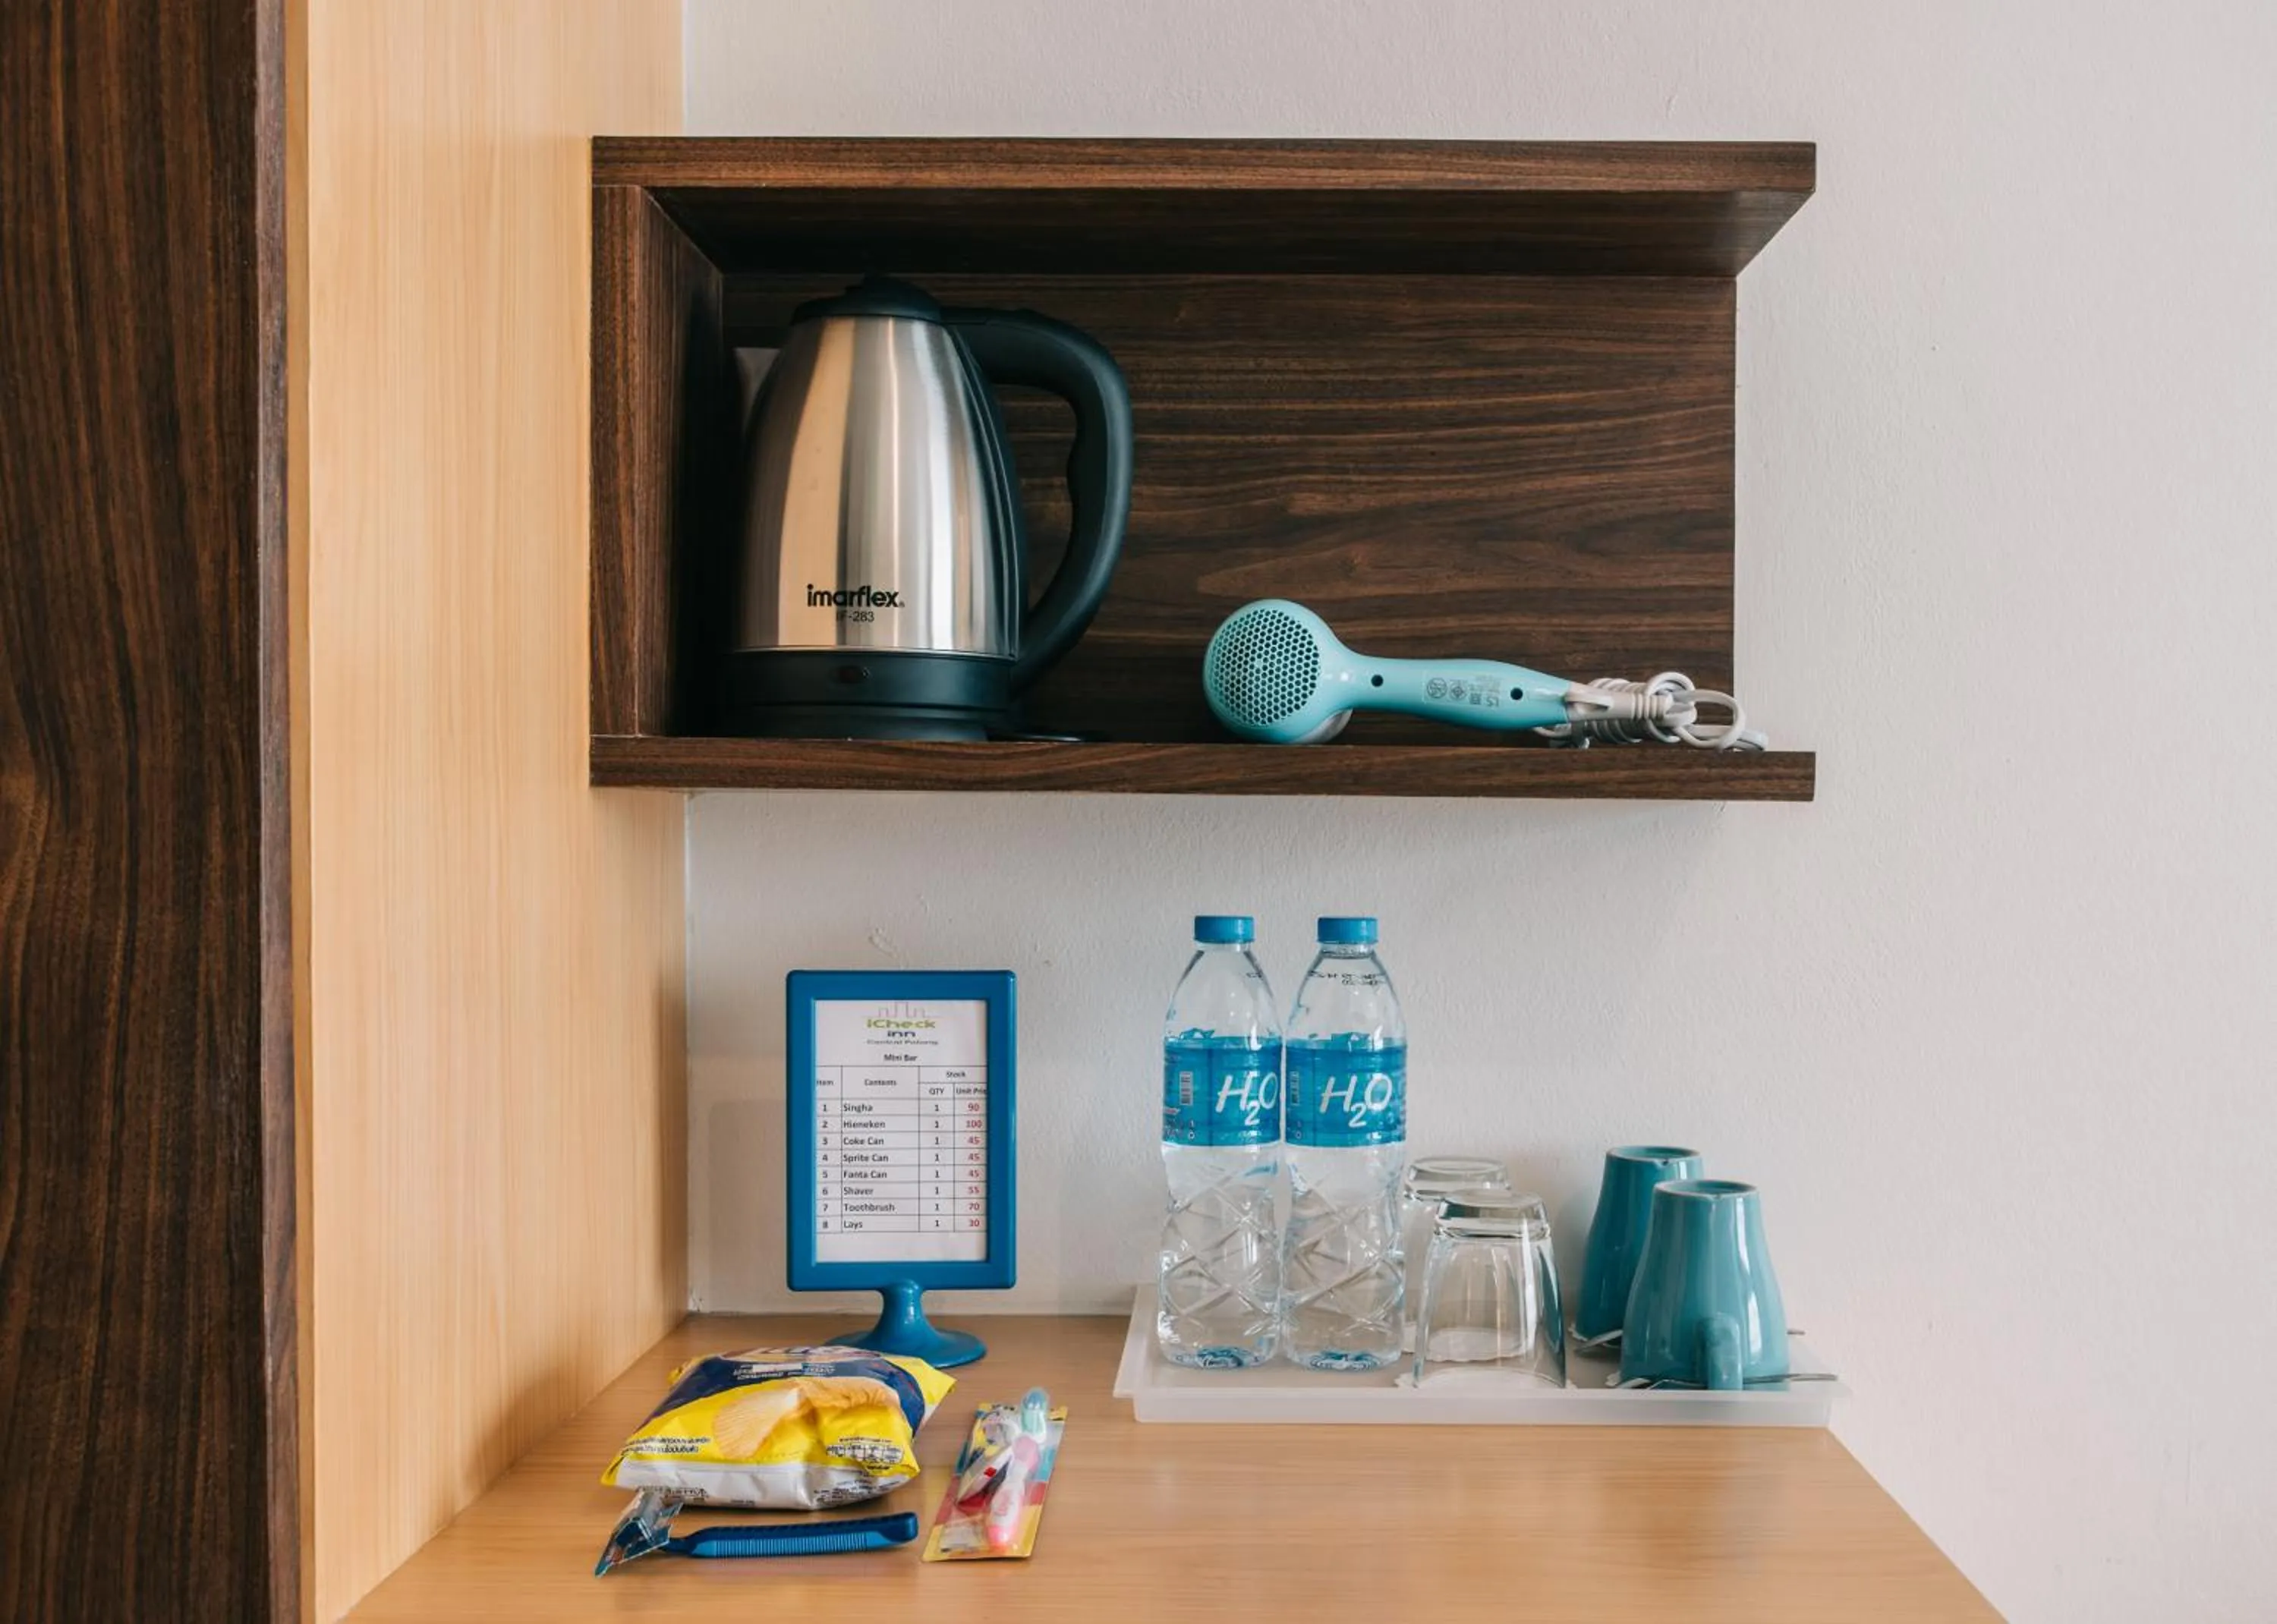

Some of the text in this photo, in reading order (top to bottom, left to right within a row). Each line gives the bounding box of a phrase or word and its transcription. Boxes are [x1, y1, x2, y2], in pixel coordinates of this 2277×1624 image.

[807, 584, 899, 608] imarflex
[866, 1018, 937, 1029] iCheck
[887, 1030, 916, 1038] inn
[883, 1053, 918, 1062] Mini Bar
[945, 1071, 966, 1079] Stock
[864, 1078, 897, 1087] Contents
[928, 1087, 945, 1096] QTY
[956, 1087, 972, 1095] Unit
[1319, 1072, 1393, 1128] H2O
[822, 1103, 981, 1114] 1 Singha 1 90
[822, 1119, 982, 1129] 2 Hieneken 1 100
[822, 1136, 981, 1146] 3 Coke Can 1 45
[822, 1152, 981, 1164] 4 Sprite Can 1 45
[822, 1169, 981, 1179] 5 Fanta Can 1 45
[822, 1185, 981, 1196] 6 Shaver 1 55
[822, 1201, 981, 1213] 7 Toothbrush 1 70
[843, 1219, 864, 1229] Lays
[934, 1219, 940, 1228] 1
